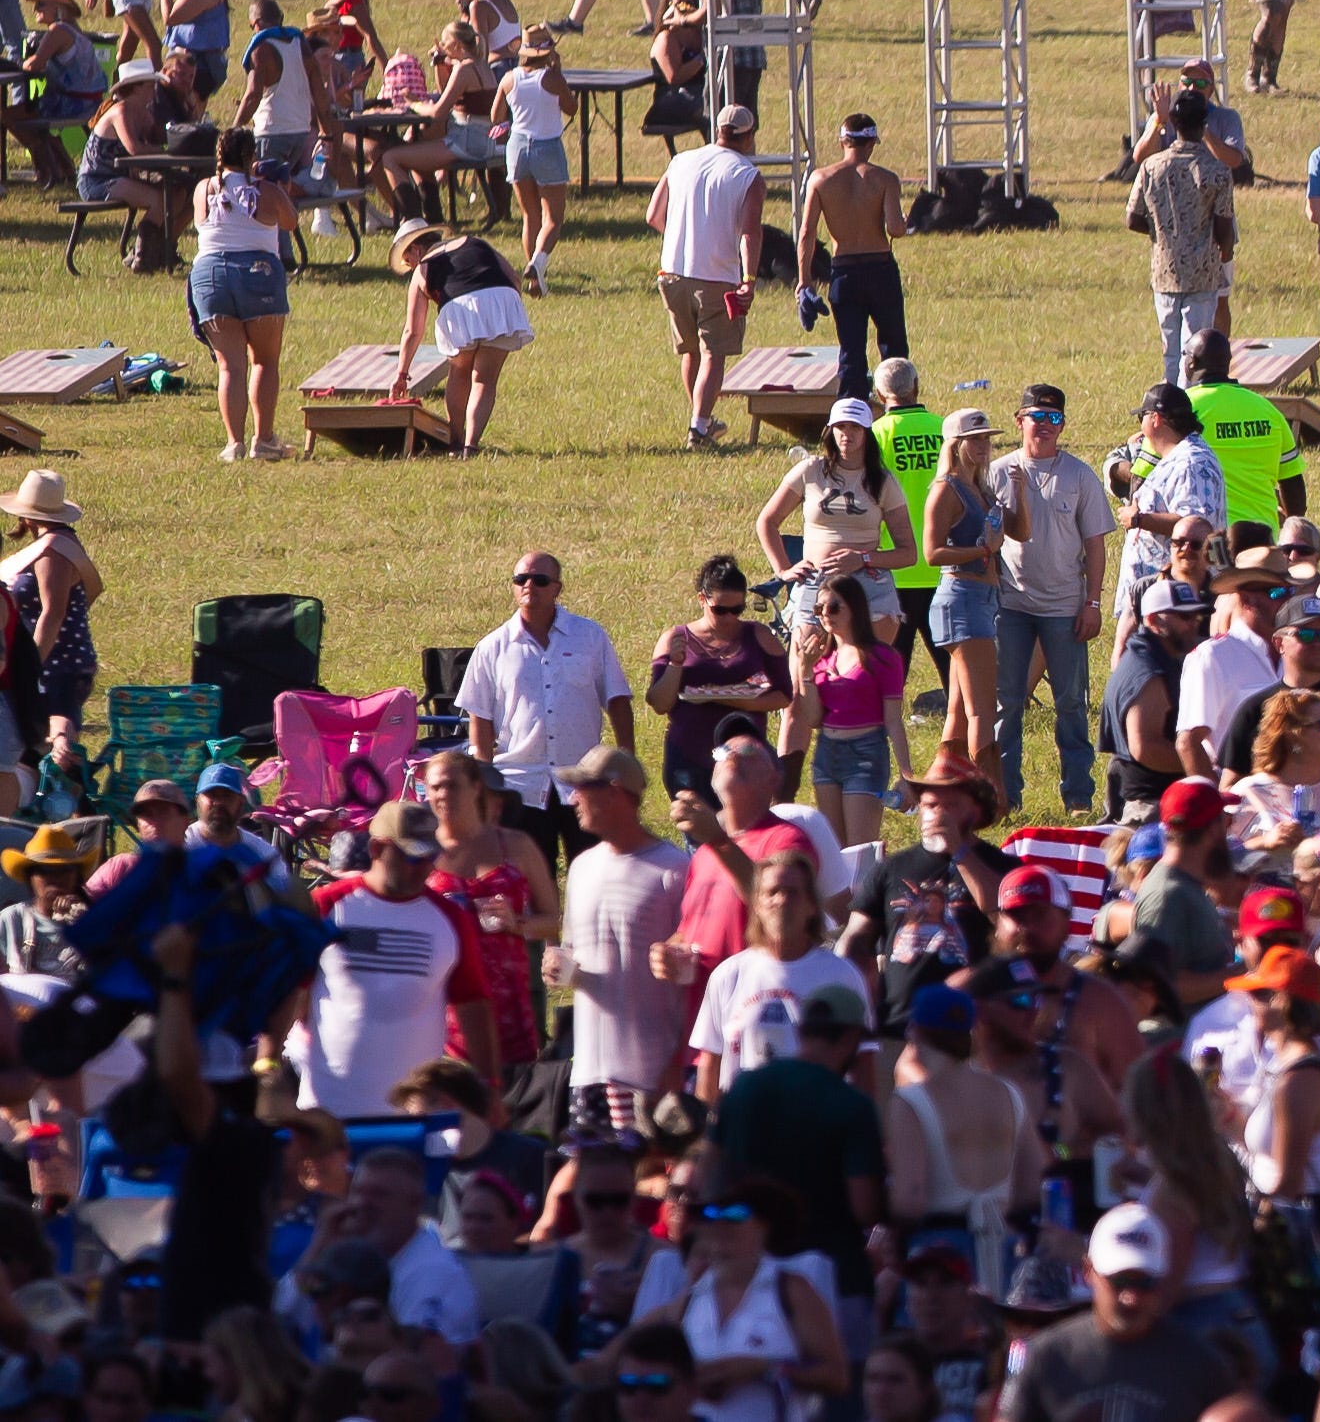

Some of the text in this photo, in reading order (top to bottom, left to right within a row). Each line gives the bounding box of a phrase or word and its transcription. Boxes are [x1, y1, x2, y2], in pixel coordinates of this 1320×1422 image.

[1216, 419, 1272, 439] EVENT STAFF
[892, 434, 944, 454] EVENT
[895, 453, 938, 472] STAF
